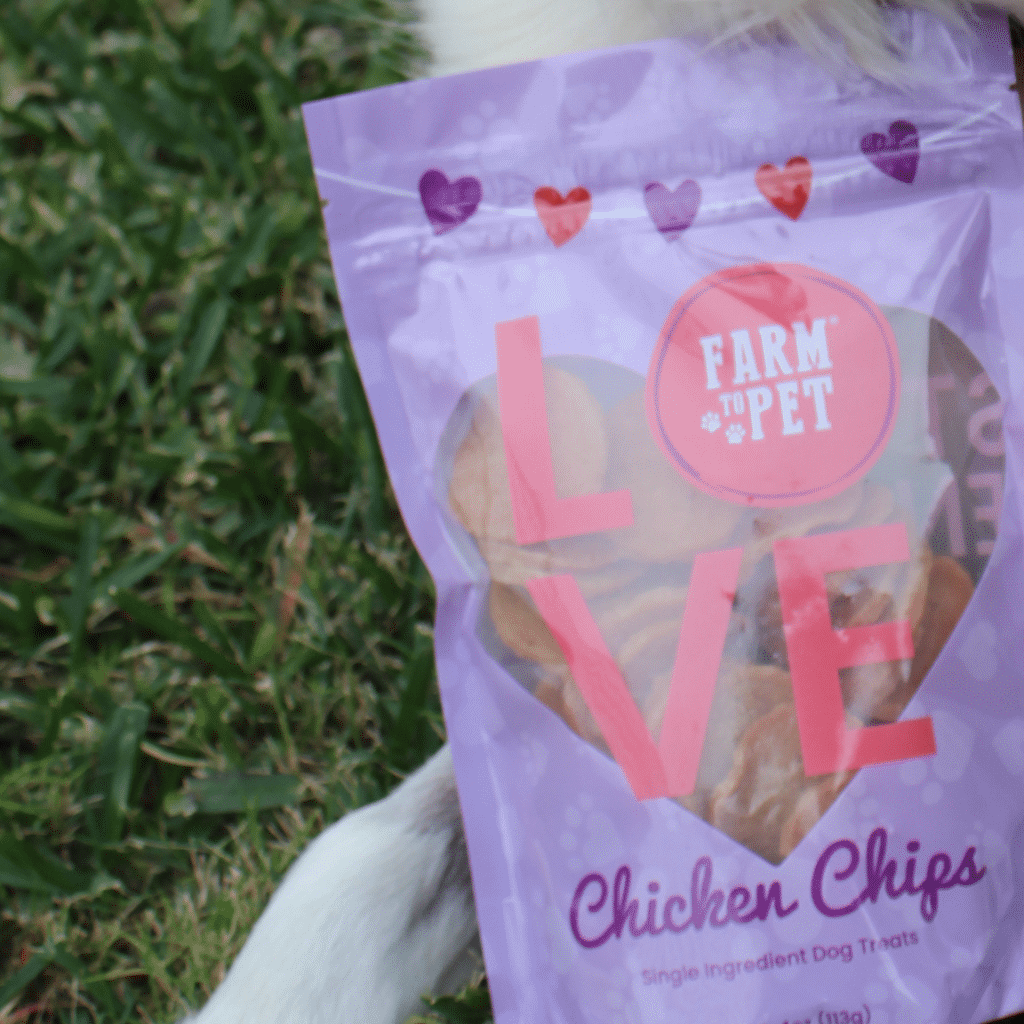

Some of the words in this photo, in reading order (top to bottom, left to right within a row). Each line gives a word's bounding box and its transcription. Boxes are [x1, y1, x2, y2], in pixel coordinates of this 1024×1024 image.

[699, 318, 834, 390] FARM
[718, 390, 745, 417] TO
[745, 375, 834, 441] PET
[570, 856, 798, 949] Chicken
[811, 826, 987, 922] Chips
[642, 965, 700, 988] Single
[704, 947, 808, 982] Ingredient
[812, 942, 853, 963] Dog
[859, 930, 919, 955] Treats
